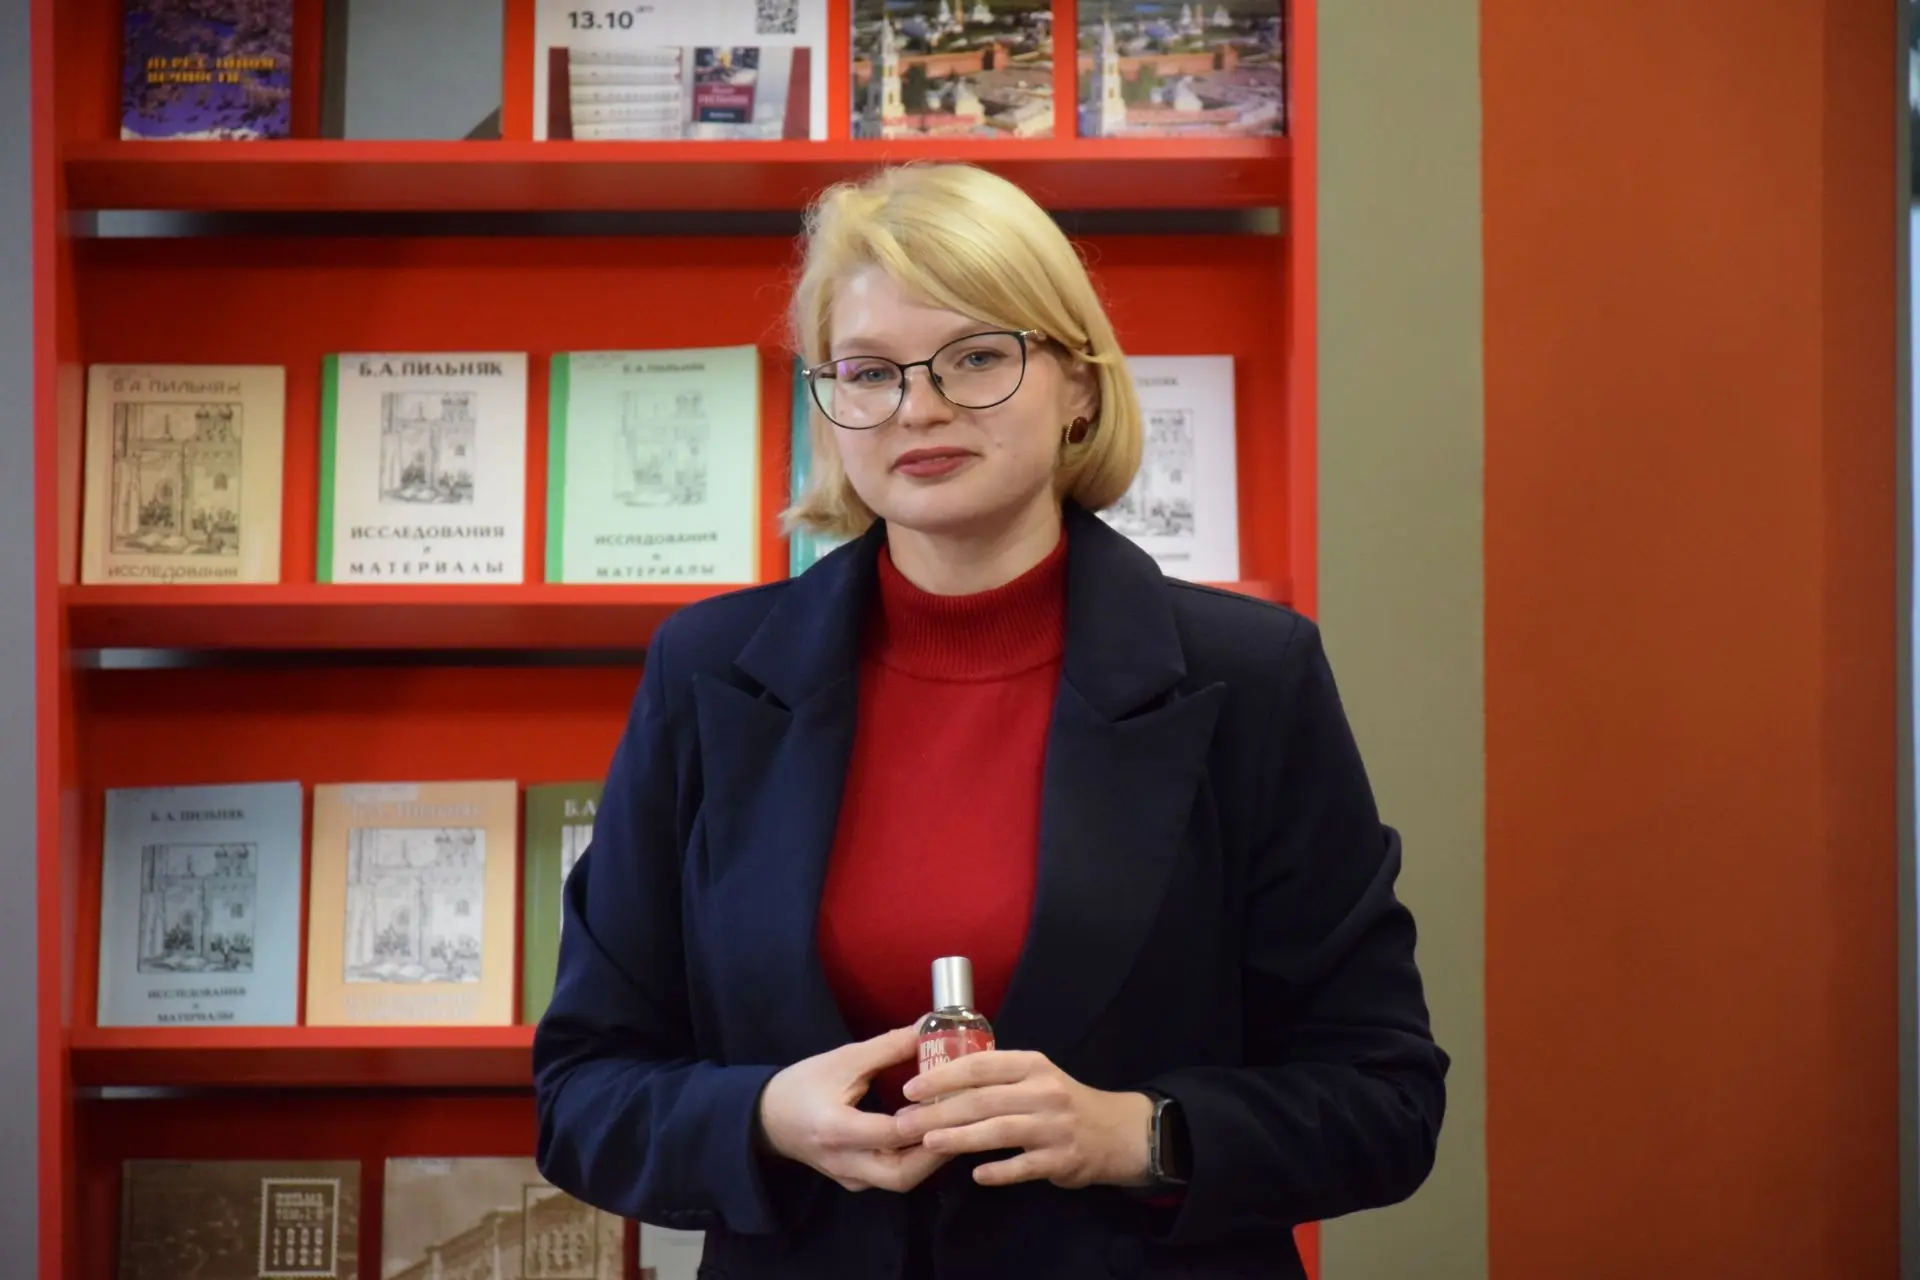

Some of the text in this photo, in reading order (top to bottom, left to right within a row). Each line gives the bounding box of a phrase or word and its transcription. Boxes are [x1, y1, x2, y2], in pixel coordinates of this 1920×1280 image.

[568, 10, 635, 30] 13.10
[402, 359, 504, 376] ПИЛЬНЯК
[350, 525, 505, 540] ИССЛЕДОВАНИЯ
[349, 561, 505, 574] МАТЕРИАЛЫ
[596, 564, 716, 577] МАТЕРИАЛЫ
